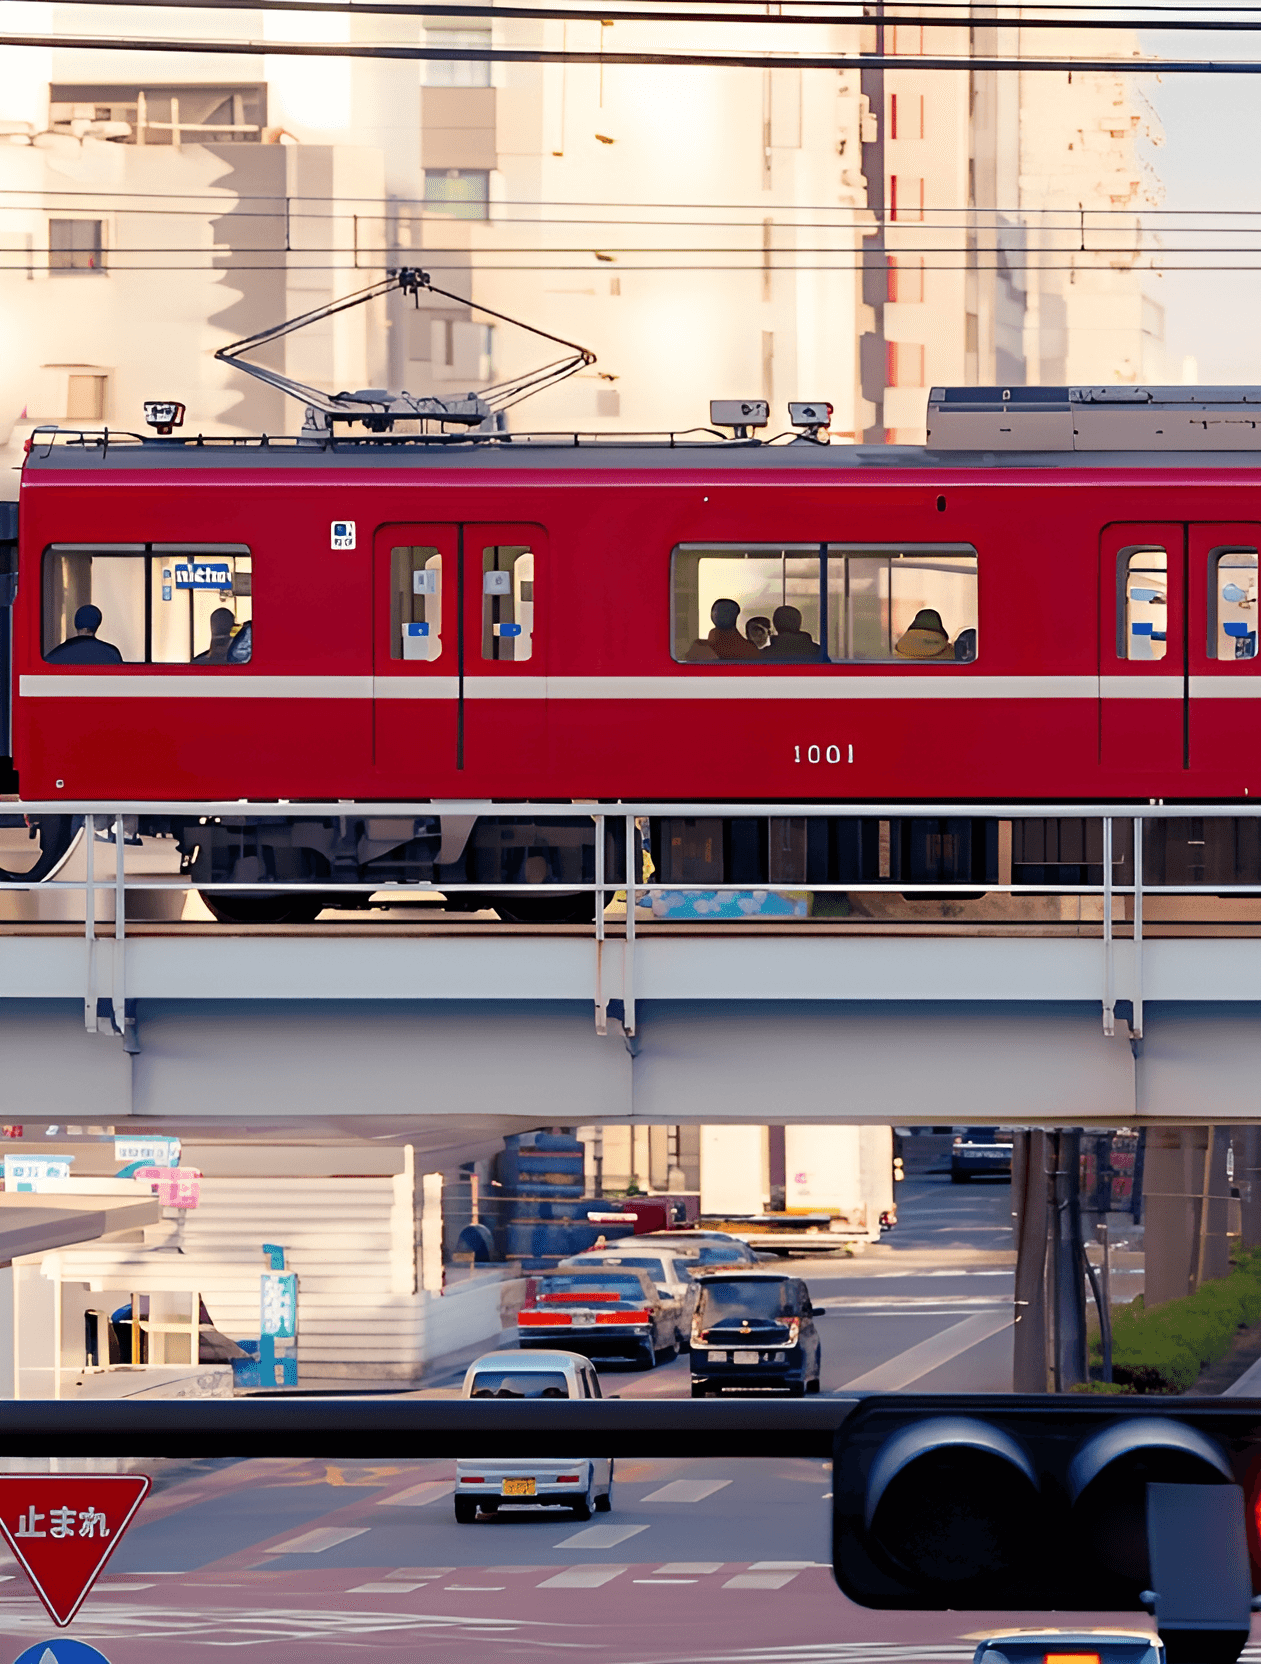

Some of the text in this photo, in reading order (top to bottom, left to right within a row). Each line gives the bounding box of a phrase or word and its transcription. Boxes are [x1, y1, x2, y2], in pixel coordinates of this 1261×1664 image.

[794, 744, 854, 764] 1001
[14, 1505, 110, 1538] 止まれ
